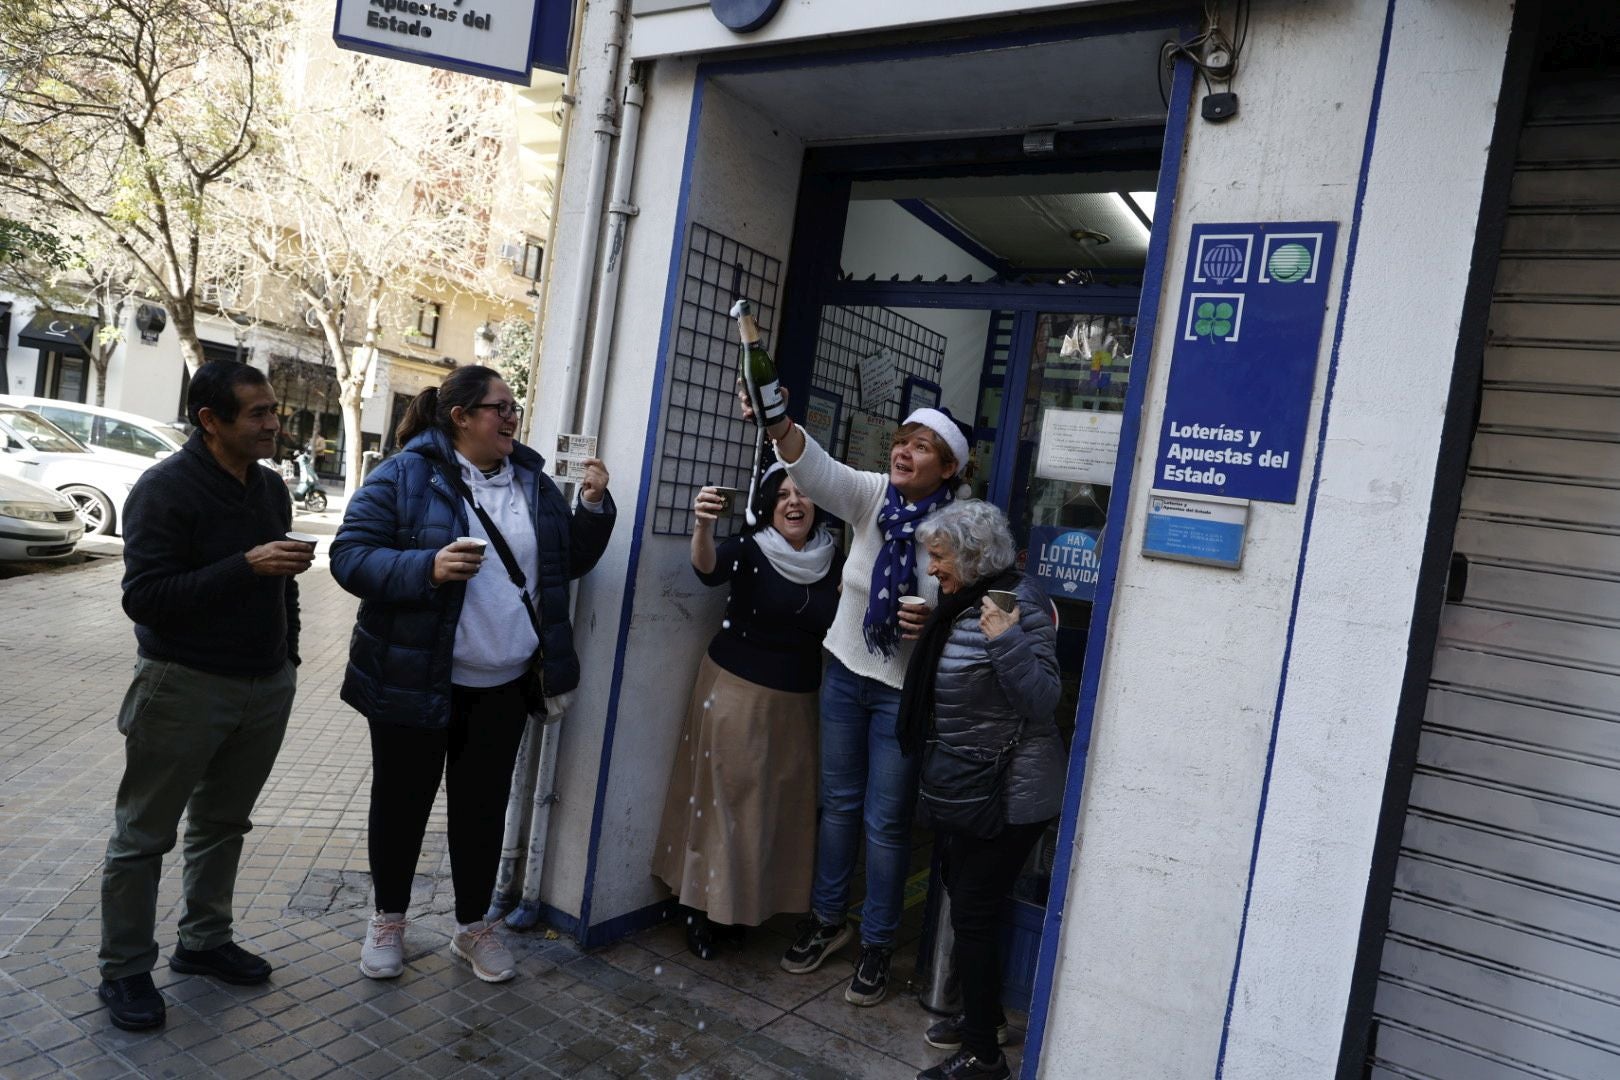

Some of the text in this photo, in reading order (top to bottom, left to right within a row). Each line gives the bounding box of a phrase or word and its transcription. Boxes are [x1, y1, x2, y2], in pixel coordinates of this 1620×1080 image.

[366, 10, 432, 38] Estado
[462, 10, 491, 30] del
[1169, 421, 1261, 448] Loterías y
[1166, 442, 1290, 469] Apuestas del
[1163, 464, 1227, 486] Estado
[1067, 534, 1087, 546] HAY
[1037, 563, 1053, 577] DE
